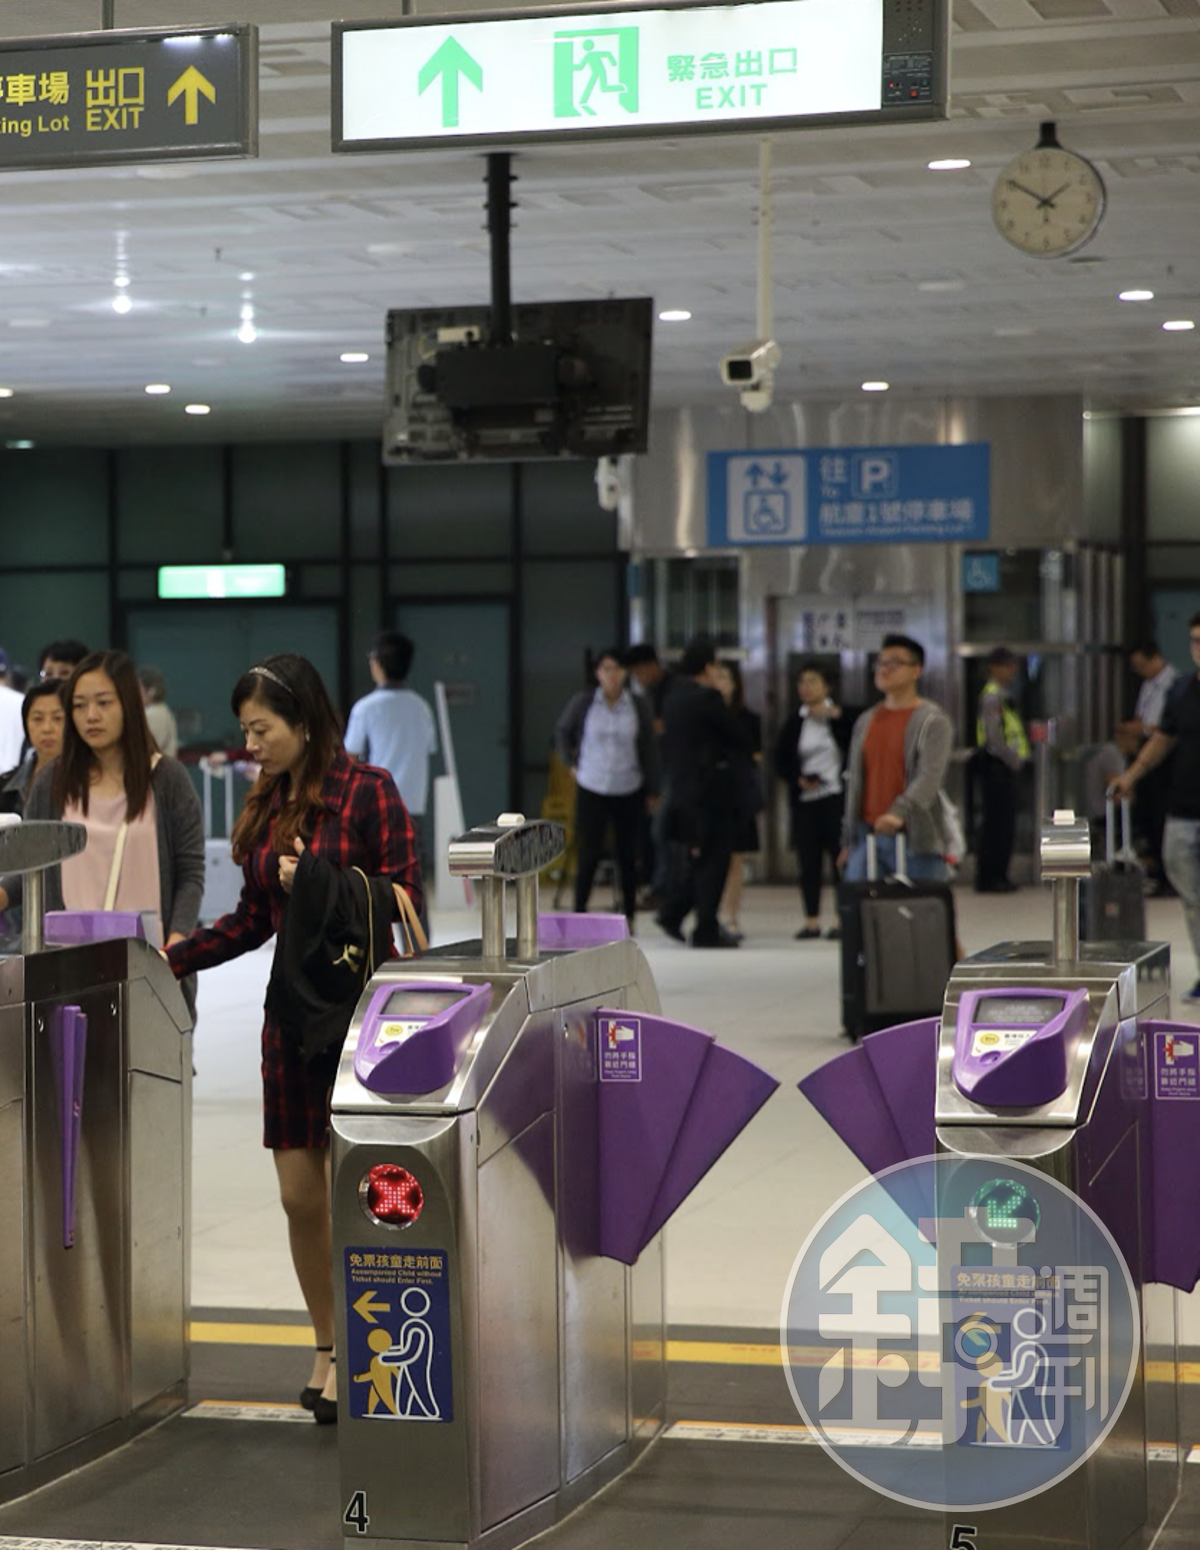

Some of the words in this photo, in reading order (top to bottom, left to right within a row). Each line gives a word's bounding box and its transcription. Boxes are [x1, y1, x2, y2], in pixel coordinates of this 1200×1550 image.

[667, 48, 798, 82] 緊急出口
[86, 67, 145, 108] 出口
[696, 83, 768, 110] EXIT
[38, 115, 70, 132] Lot
[86, 107, 145, 131] EXIT
[820, 456, 847, 483] 往
[861, 458, 891, 494] P
[350, 1254, 442, 1268] 免票孩童走前面
[343, 1490, 370, 1535] 4
[949, 1524, 979, 1550] 5
